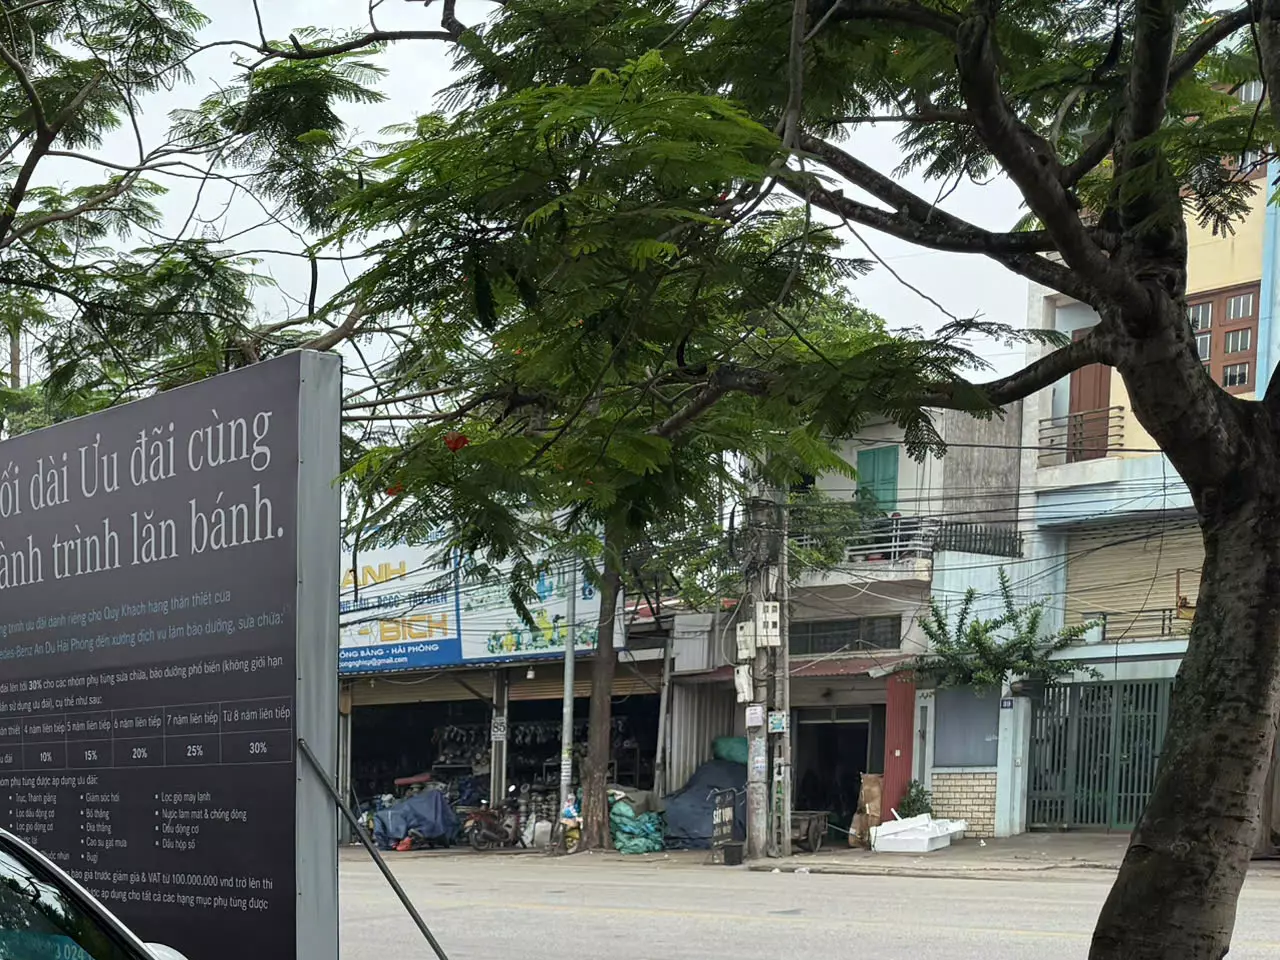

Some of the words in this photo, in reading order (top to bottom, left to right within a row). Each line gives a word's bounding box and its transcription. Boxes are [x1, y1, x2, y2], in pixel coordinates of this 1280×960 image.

[30, 452, 70, 510] dài
[79, 433, 120, 498] Ưu
[130, 422, 176, 487] đãi
[188, 409, 272, 472] cùng
[52, 518, 121, 580] trình
[131, 509, 179, 566] lăn
[188, 483, 284, 555] bánh.
[34, 642, 44, 655] An
[45, 640, 56, 654] Du
[28, 679, 42, 690] 30%
[43, 678, 54, 689] cho
[268, 655, 282, 670] hạn
[166, 714, 171, 725] 7
[234, 710, 239, 721] 8
[24, 724, 28, 734] 4
[67, 722, 71, 732] 5
[492, 722, 505, 732] 85
[132, 748, 148, 759] 20%
[187, 745, 204, 756] 25%
[250, 742, 267, 754] 30%
[40, 752, 52, 762] 10%
[84, 750, 98, 761] 15%
[141, 870, 146, 883] &
[148, 872, 161, 884] VAT
[172, 874, 218, 886] 100.000.000
[128, 890, 140, 900] cho
[248, 896, 268, 912] được
